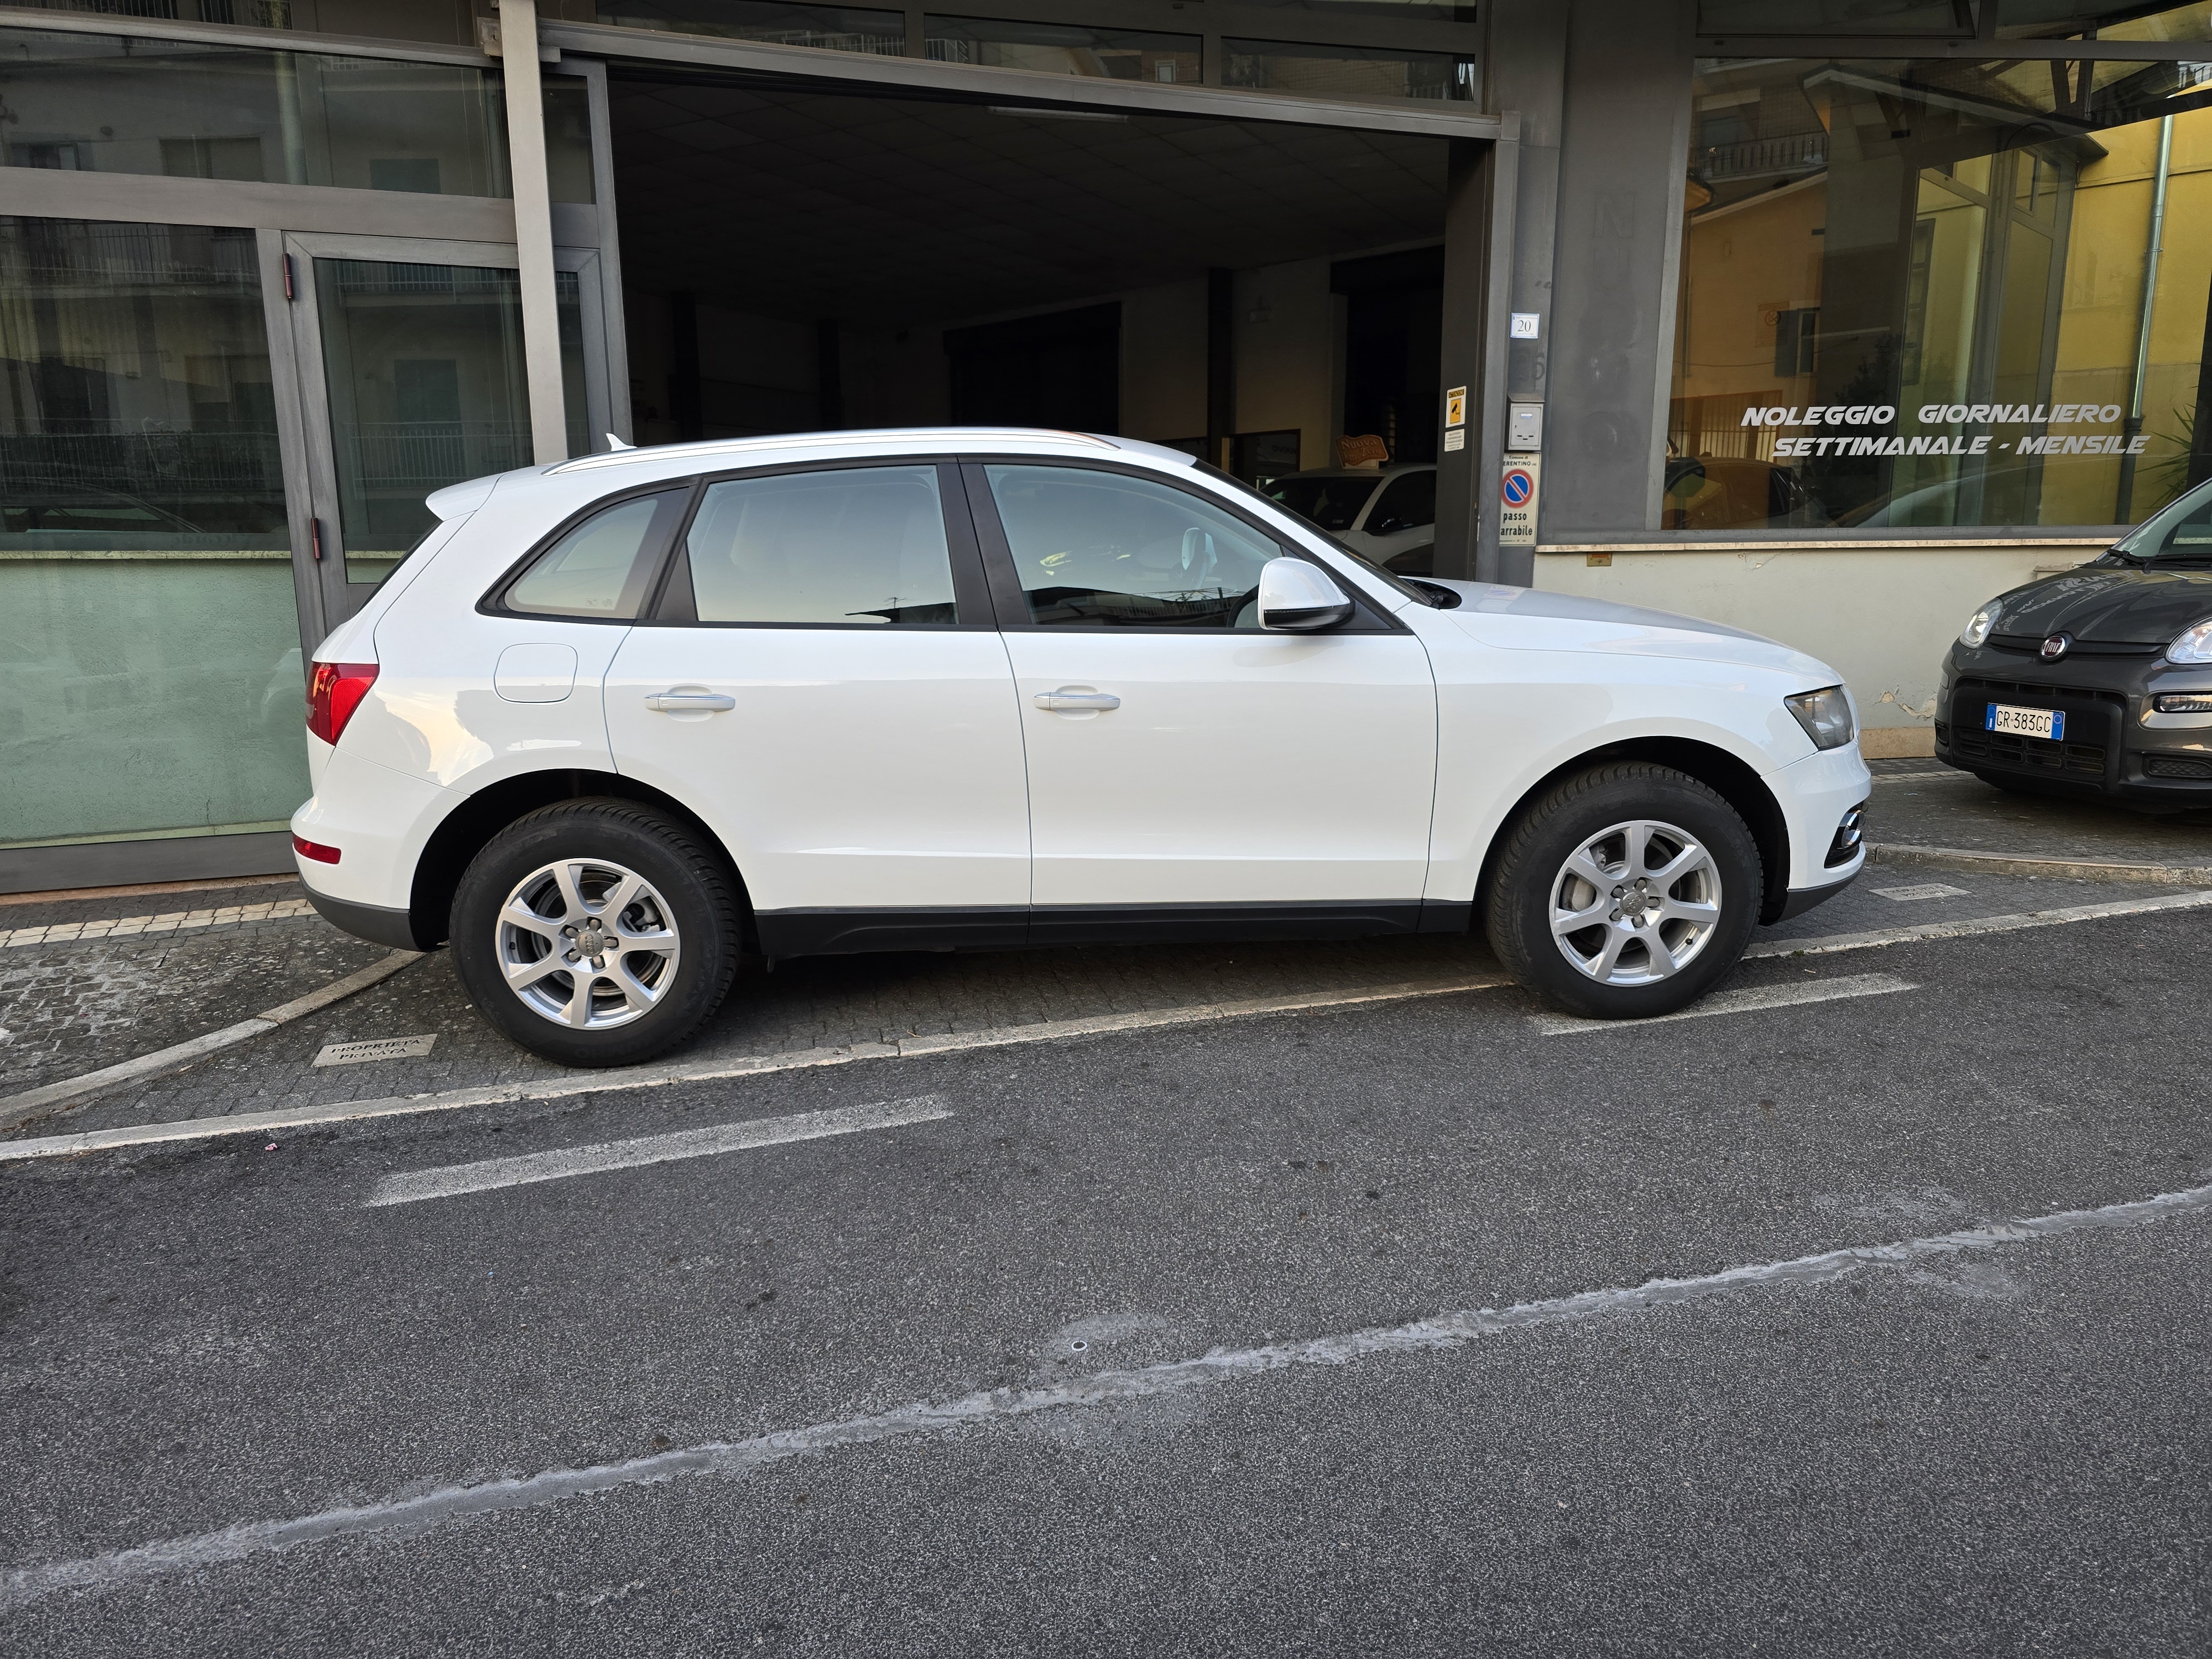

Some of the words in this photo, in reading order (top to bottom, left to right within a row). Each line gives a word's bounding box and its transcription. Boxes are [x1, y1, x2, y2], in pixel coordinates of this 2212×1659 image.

[1517, 320, 1531, 332] 20
[1741, 405, 1896, 426] NOLEGGIO
[1918, 404, 2122, 425] GIORNALIERO
[1340, 440, 1378, 450] Nuova
[1771, 436, 1992, 457] SETTIMANALE
[2016, 435, 2152, 455] MENSILE
[1360, 447, 1381, 457] Zero
[1503, 513, 1527, 524] passo
[1500, 525, 1533, 536] arrabile
[2045, 642, 2061, 653] FIAT
[340, 1047, 407, 1060] PRIVATA
